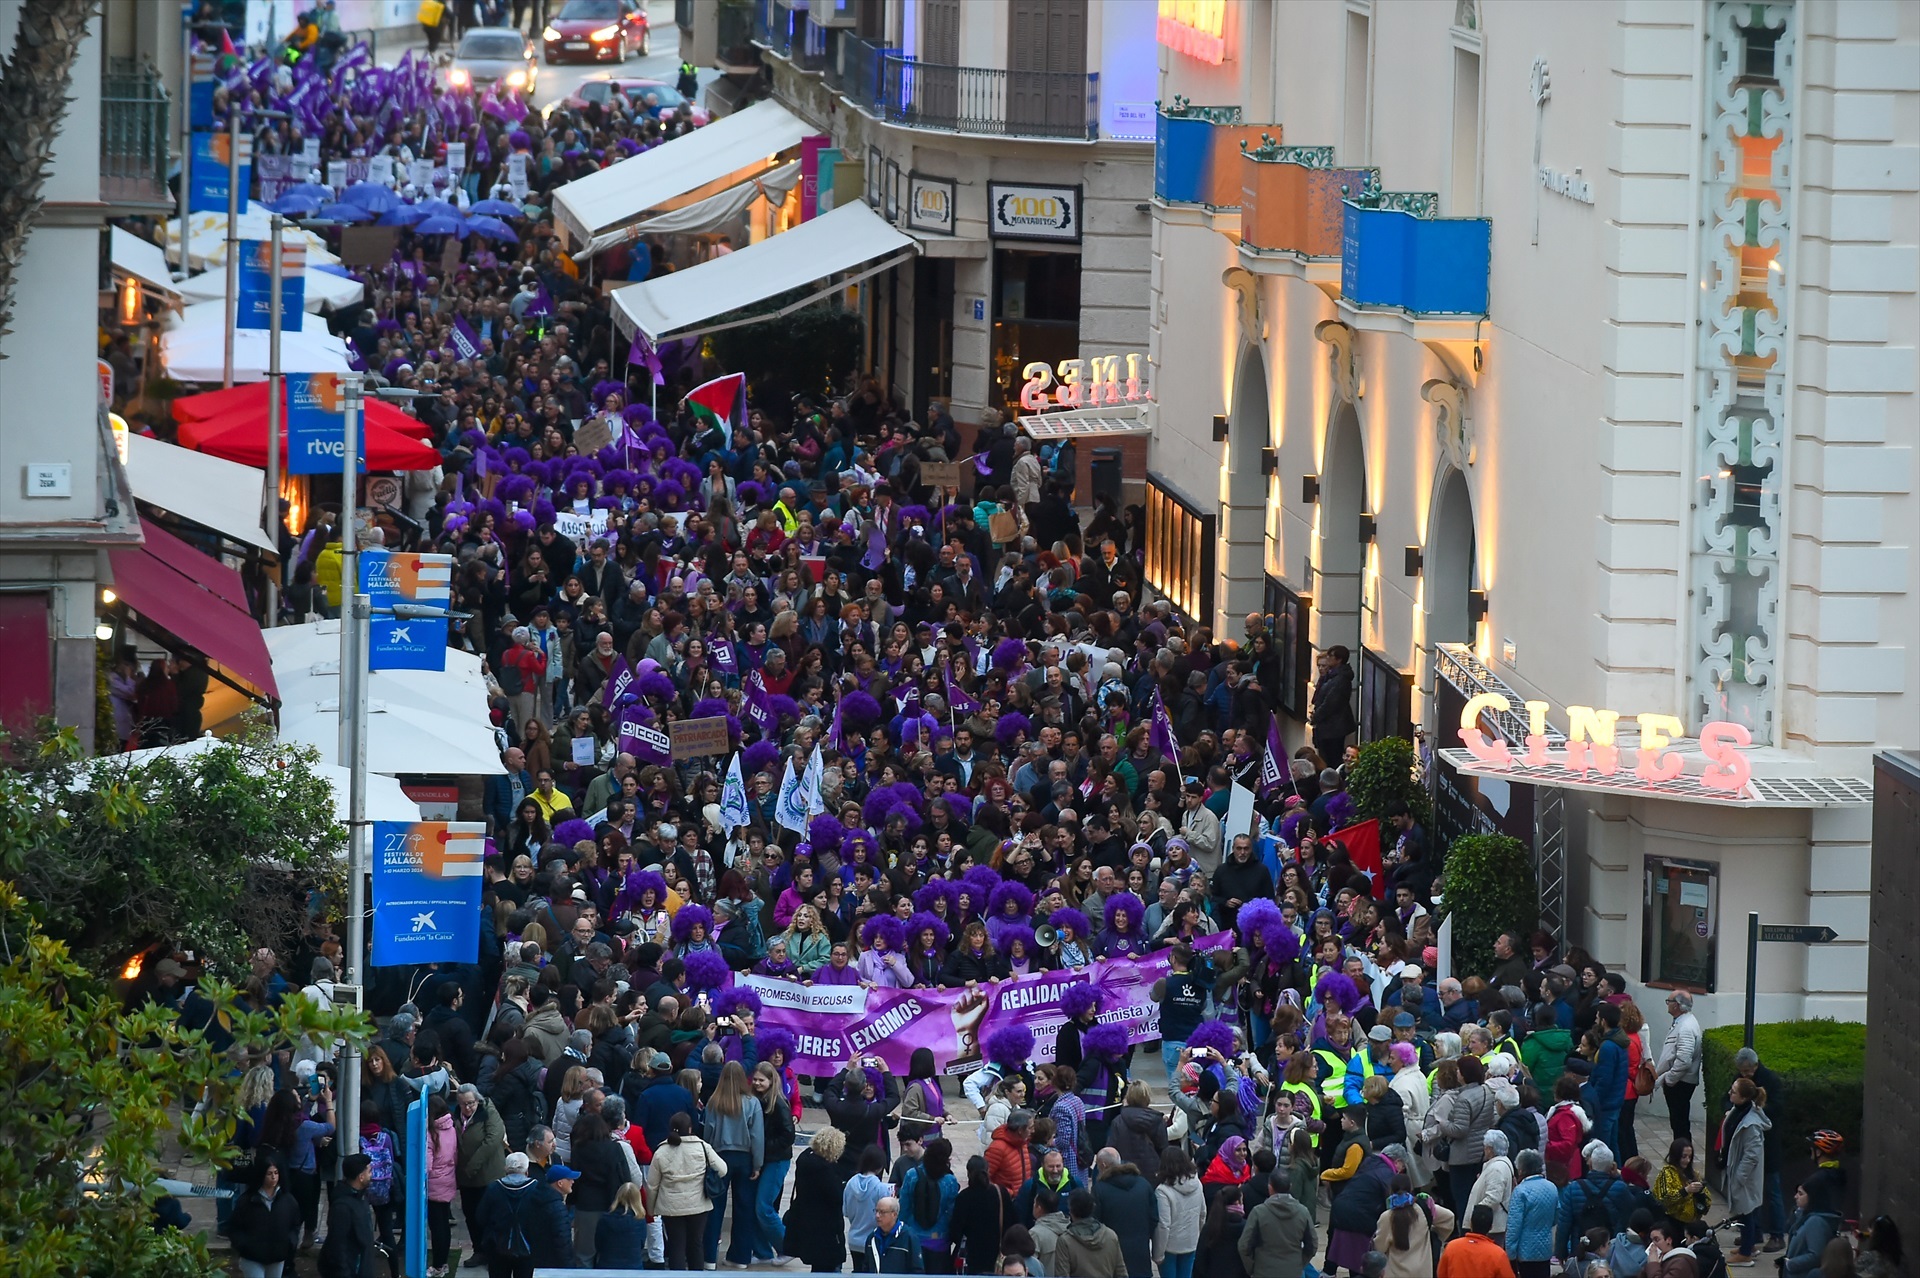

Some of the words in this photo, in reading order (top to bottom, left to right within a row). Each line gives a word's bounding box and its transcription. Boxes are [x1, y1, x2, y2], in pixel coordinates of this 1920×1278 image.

[921, 190, 943, 211] 100
[1010, 196, 1057, 218] 100
[1011, 215, 1058, 226] MONTADITOS
[294, 380, 310, 394] 27
[307, 438, 345, 457] rtve
[368, 560, 388, 577] 27
[637, 727, 668, 746] CCOO
[673, 729, 727, 744] PATRIARCADO
[1457, 692, 1752, 789] CINES
[384, 833, 408, 851] 27
[394, 933, 426, 942] Fundación
[434, 931, 455, 940] Caixa"
[754, 986, 801, 1003] PROMESAS
[801, 995, 811, 1005] NI
[811, 994, 854, 1006] EXCUSAS
[1145, 1004, 1154, 1017] y
[850, 998, 922, 1051] EXIGIMOS
[1138, 1019, 1159, 1034] Má
[791, 1034, 841, 1057] JERES
